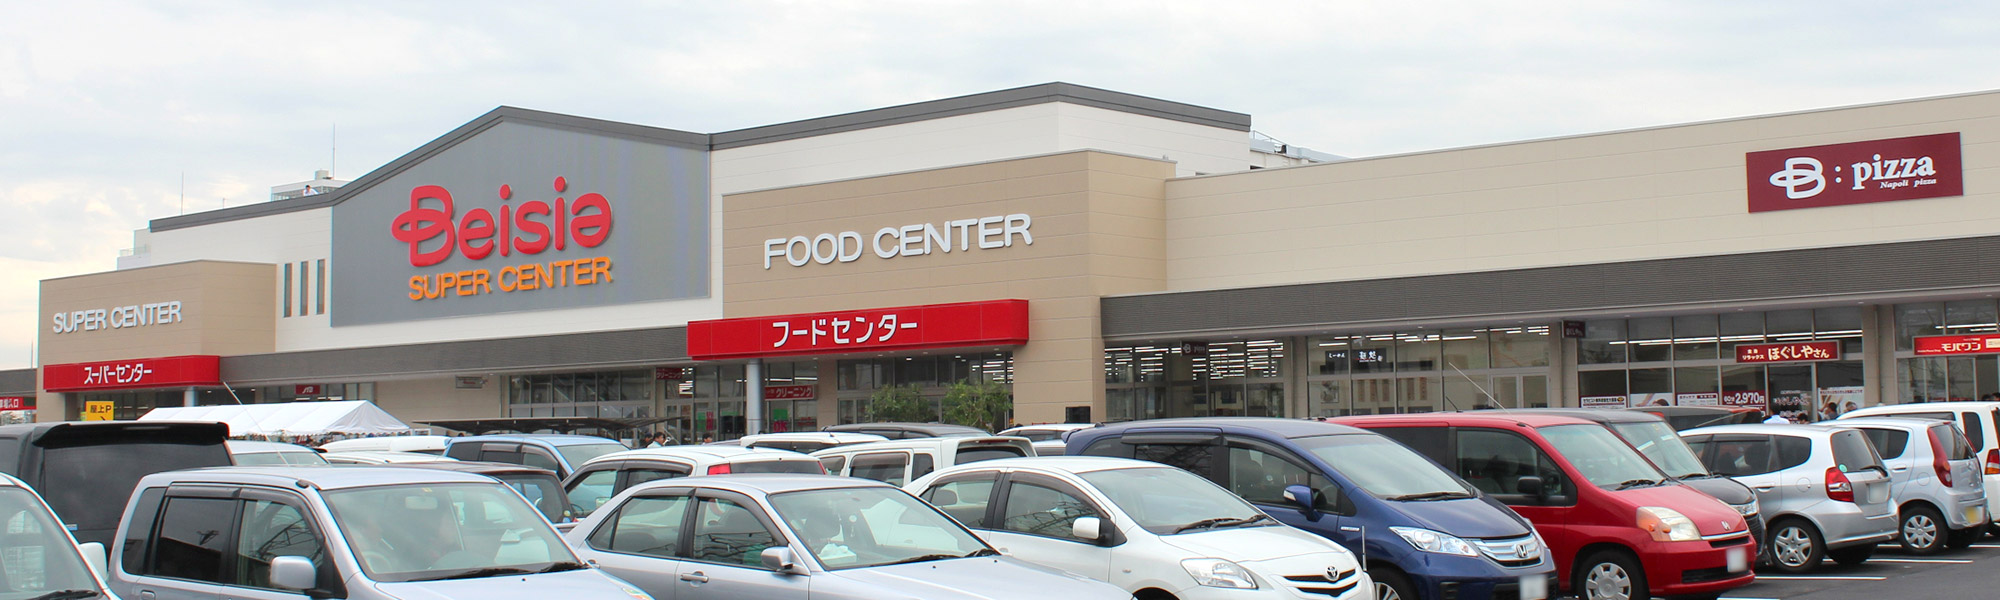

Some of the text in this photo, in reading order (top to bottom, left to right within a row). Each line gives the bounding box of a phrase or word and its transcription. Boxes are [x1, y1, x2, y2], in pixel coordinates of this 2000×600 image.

[1852, 153, 1937, 190] pizza
[1880, 178, 1937, 190] Napoli pizza
[391, 176, 613, 267] Beisia
[764, 213, 1034, 270] FOOD CENTER
[409, 256, 613, 301] SUPER CENTER
[53, 300, 183, 334] SUPER CENTER
[773, 315, 919, 349] フードセンター
[1768, 345, 1830, 360] ほぐしやさん
[84, 364, 153, 385] スーパーセンター
[776, 387, 812, 398] クリーニング
